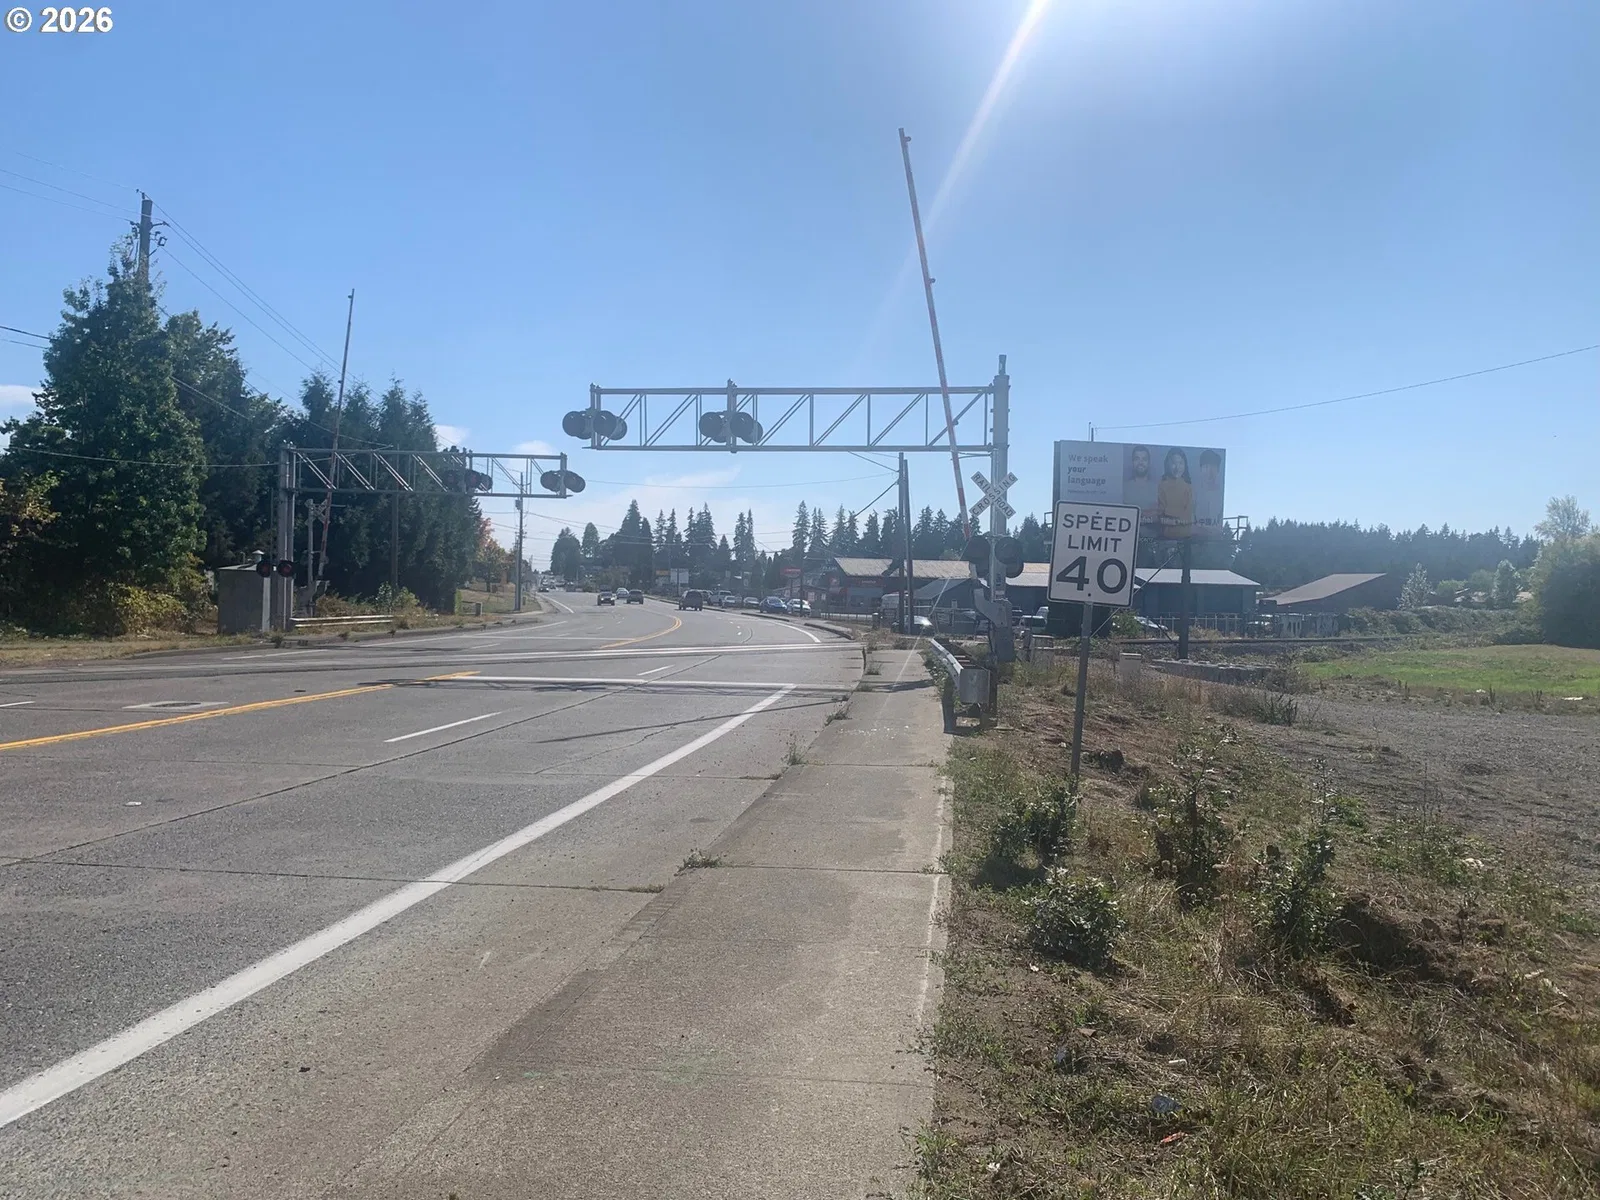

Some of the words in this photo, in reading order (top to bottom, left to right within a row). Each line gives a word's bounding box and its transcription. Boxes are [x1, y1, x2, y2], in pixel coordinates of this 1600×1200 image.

[1068, 454, 1082, 462] We
[1083, 454, 1109, 464] speak
[1067, 466, 1086, 474] your
[1067, 475, 1106, 486] language
[972, 474, 1015, 515] CROSSING
[1062, 513, 1132, 532] SPEED
[1067, 534, 1122, 553] LIMIT
[1056, 556, 1128, 594] 40
